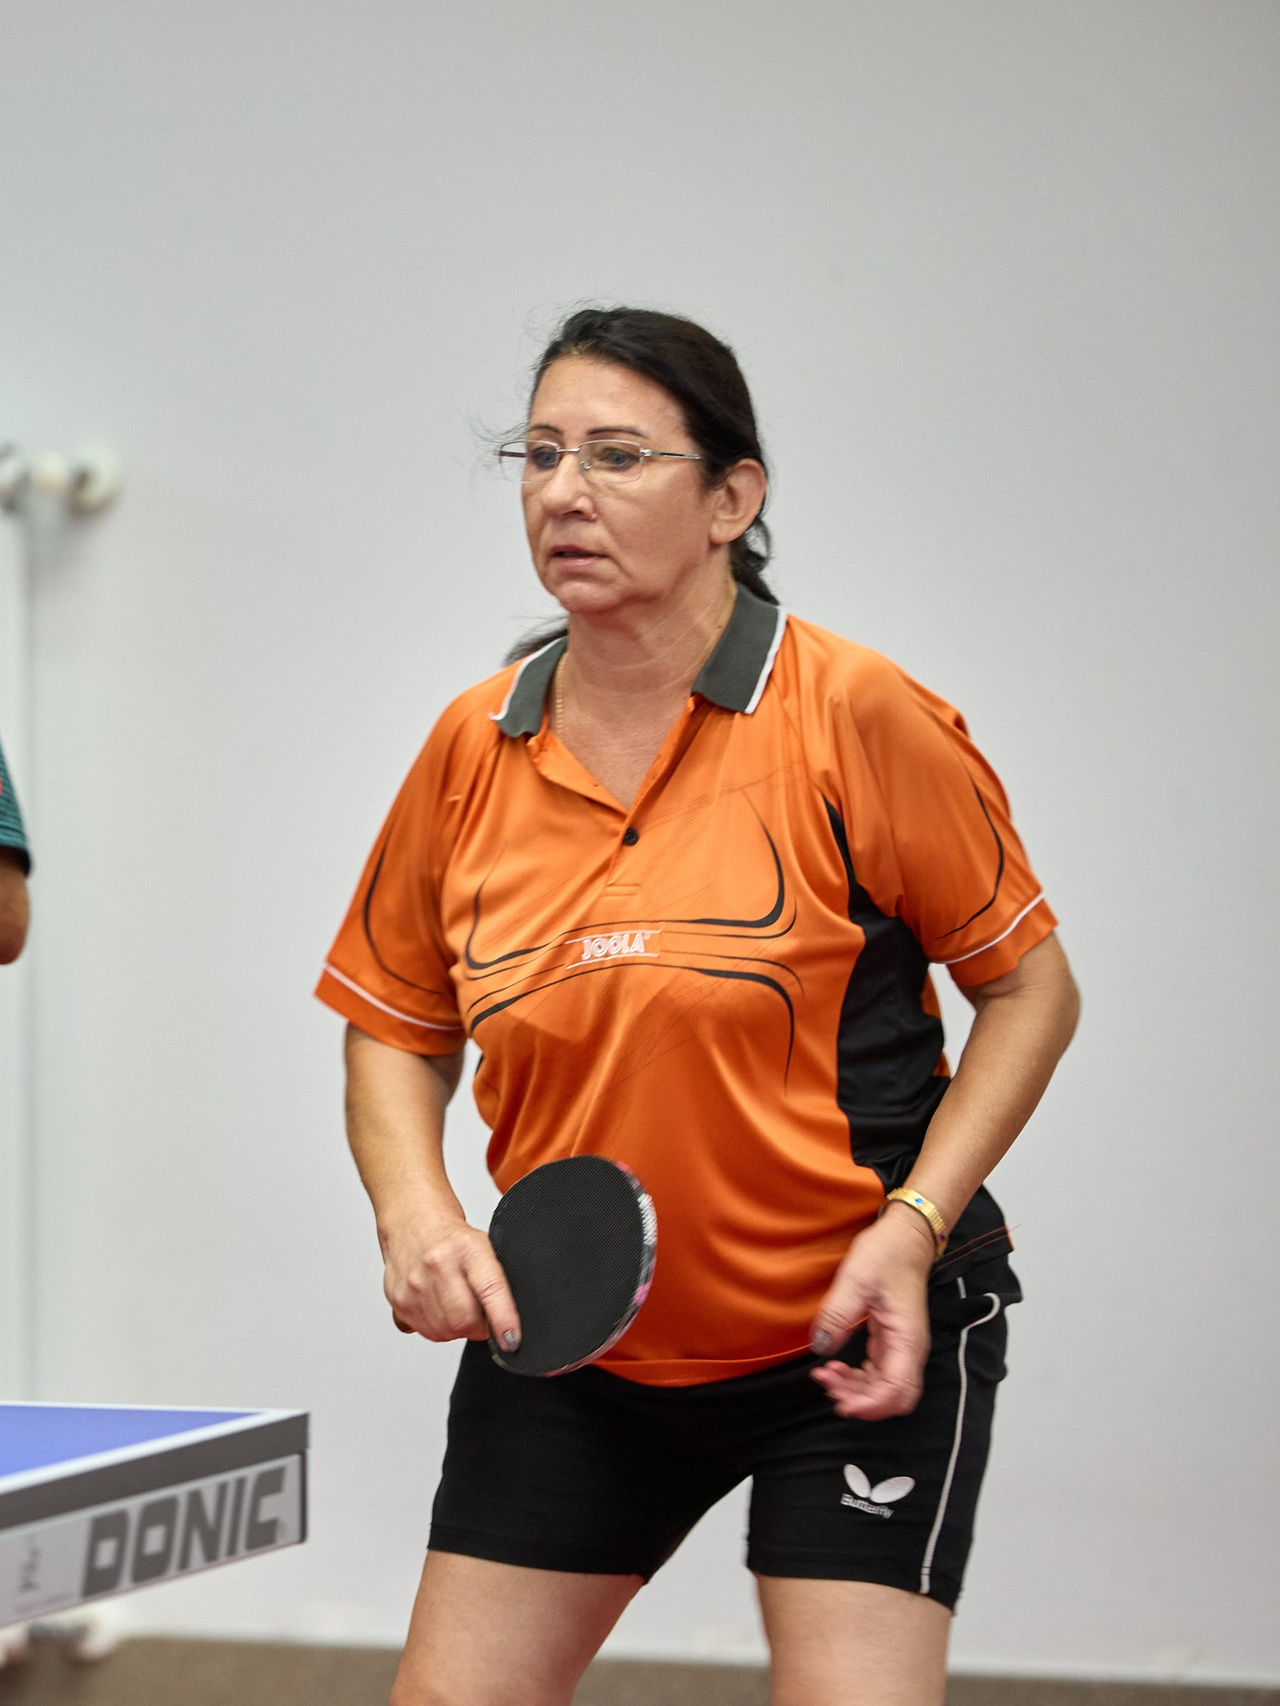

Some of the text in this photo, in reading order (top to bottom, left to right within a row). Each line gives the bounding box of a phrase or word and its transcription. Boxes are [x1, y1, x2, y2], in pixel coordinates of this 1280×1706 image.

[582, 932, 646, 960] JOOLA
[840, 1493, 895, 1519] Butterfly
[82, 1466, 286, 1598] DONIC
